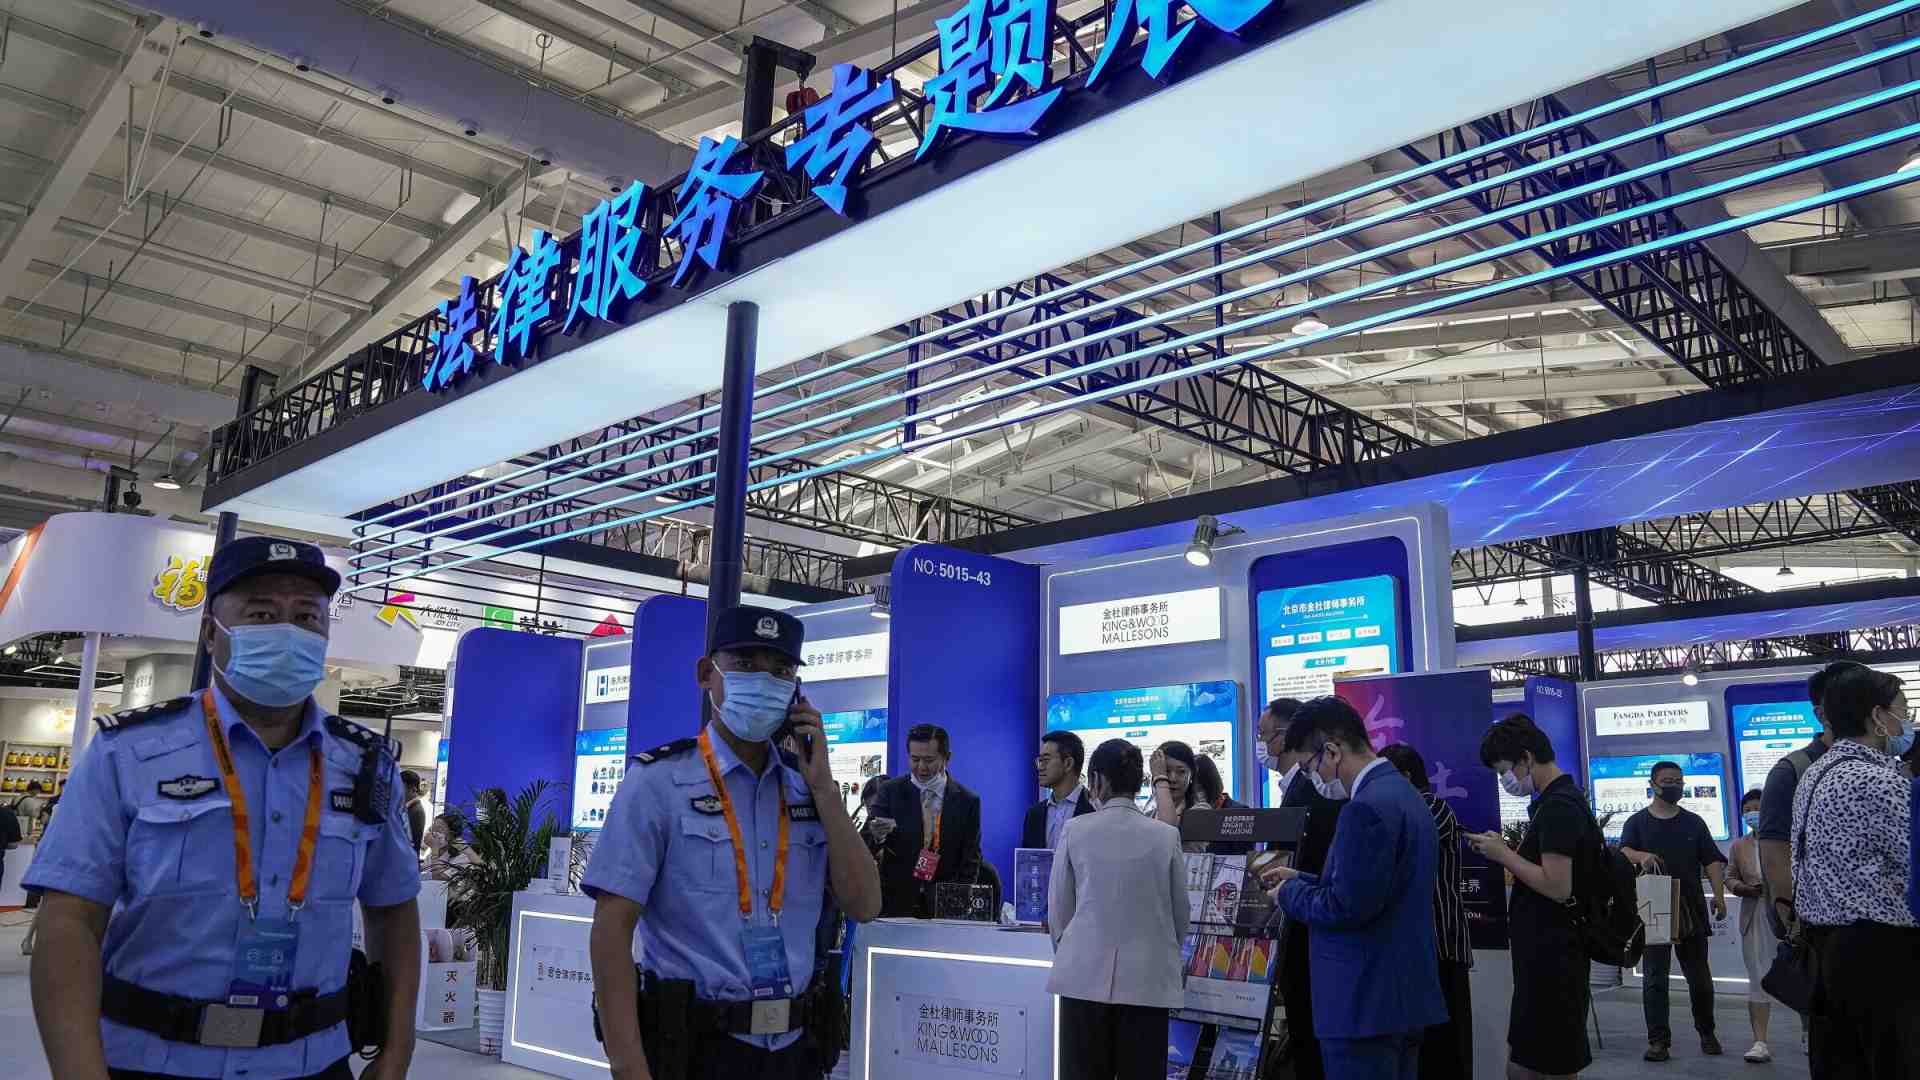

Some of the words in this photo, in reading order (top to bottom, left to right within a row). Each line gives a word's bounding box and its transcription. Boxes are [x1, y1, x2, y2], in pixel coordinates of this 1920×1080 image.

[1103, 600, 1168, 621] 金杜律师事务所
[1102, 627, 1169, 645] MALLESONS
[1613, 711, 1645, 721] FANGDA
[1648, 708, 1689, 719] PARTNERS
[918, 1003, 1000, 1028] 金杜律师事务所
[917, 1021, 1000, 1046] KING&WOOD
[916, 1037, 999, 1064] MALLESONS
